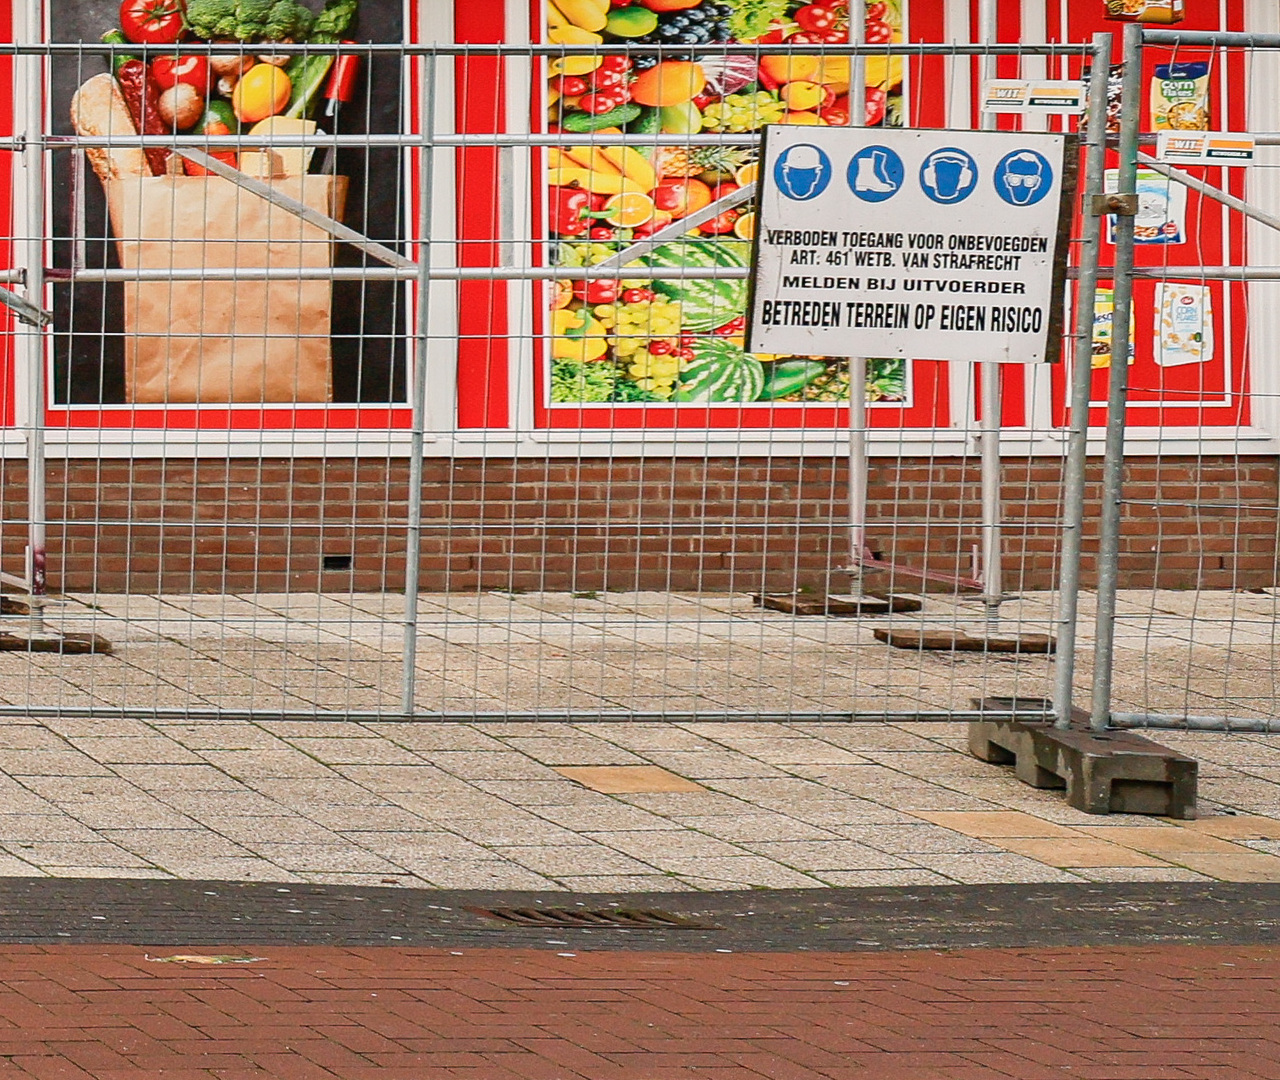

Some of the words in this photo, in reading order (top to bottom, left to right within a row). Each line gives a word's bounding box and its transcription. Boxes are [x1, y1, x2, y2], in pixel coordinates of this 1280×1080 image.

[995, 89, 1020, 98] WIT
[1173, 140, 1197, 149] WIT
[767, 229, 838, 247] VERBODEN
[842, 232, 903, 249] TOEGANG
[908, 233, 944, 249] VOOR
[948, 235, 1048, 253] ONBEVOEGDEN
[826, 251, 849, 266] 461
[855, 251, 896, 267] WETB.
[902, 252, 929, 268] VAN
[933, 253, 1021, 271] STRAFRECHT
[782, 276, 860, 290] MELDEN
[867, 278, 896, 291] BIJ
[903, 279, 1026, 294] UITVOERDER
[761, 300, 842, 327] BETREDEN
[846, 302, 910, 329] TERREIN
[915, 304, 936, 330] OP
[940, 305, 986, 331] EIGEN
[991, 307, 1043, 333] RISICO
